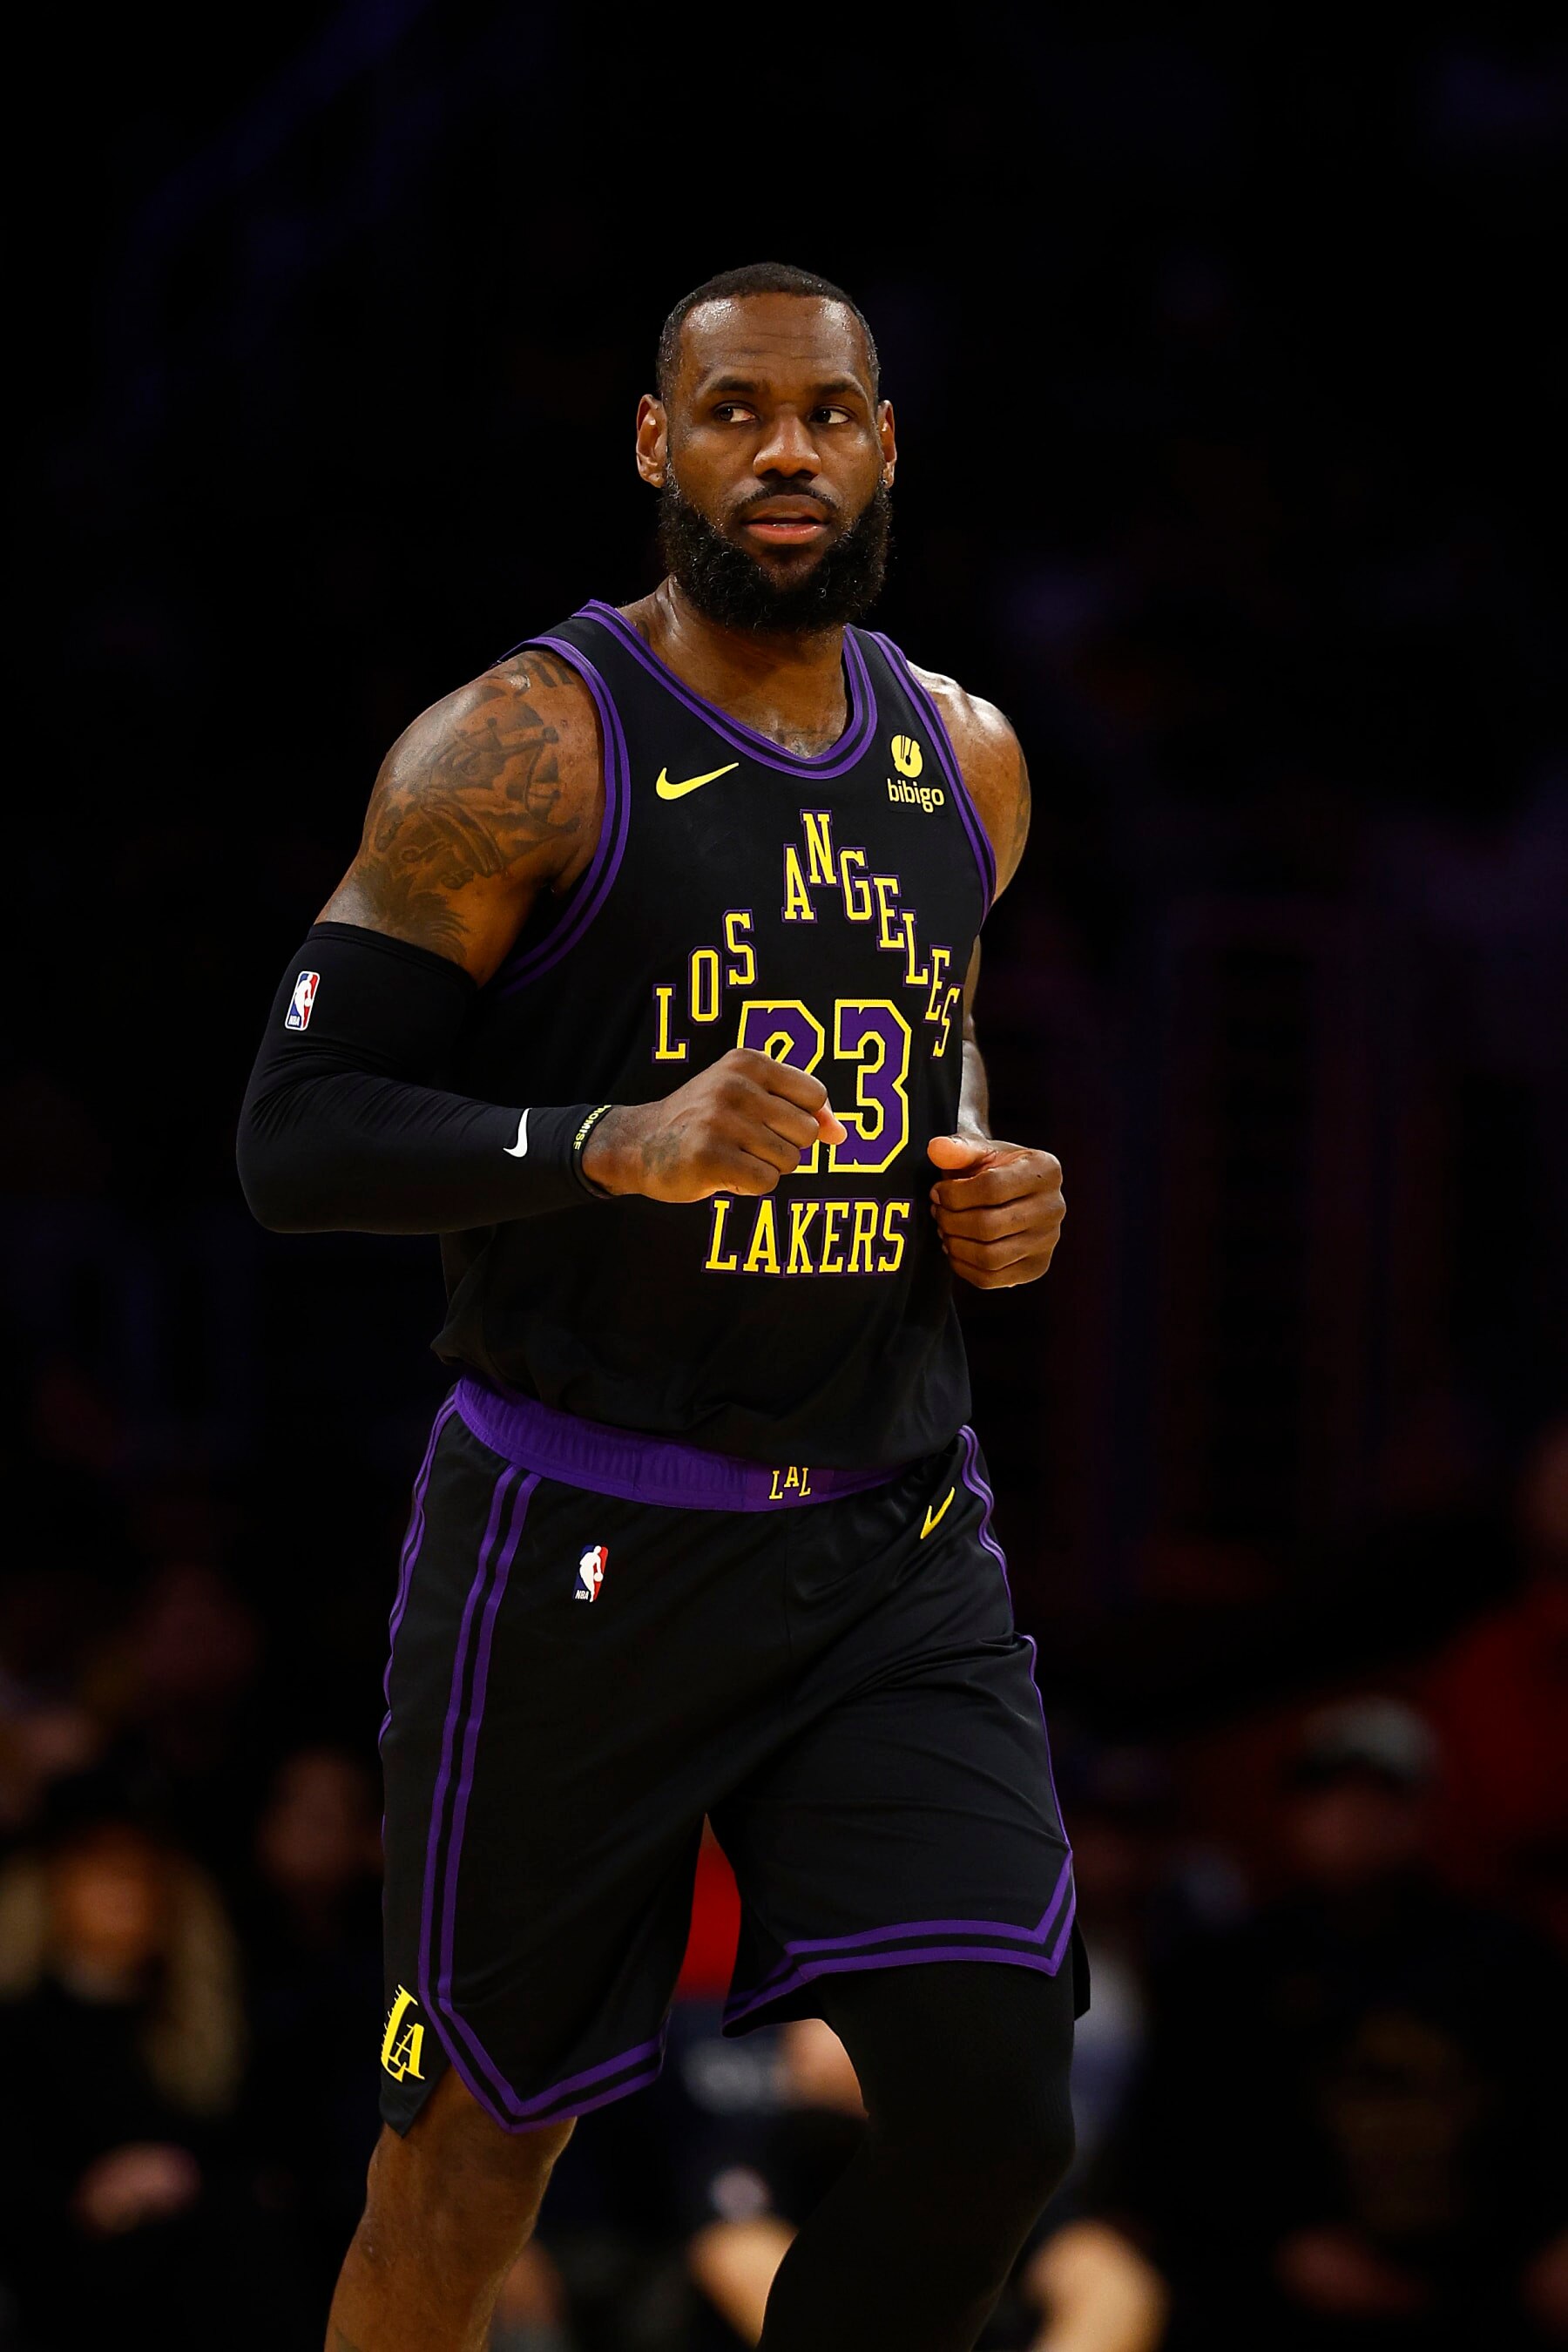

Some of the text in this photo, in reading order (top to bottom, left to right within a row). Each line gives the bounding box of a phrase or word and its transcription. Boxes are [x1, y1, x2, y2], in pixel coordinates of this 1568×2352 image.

[887, 778, 944, 813] bibigo
[652, 809, 964, 1062] LOS ANGELES
[701, 1196, 909, 1277] LAKERS
[768, 1466, 811, 1499] LAL
[575, 1590, 589, 1600] NBA
[382, 1984, 425, 2082] LA
